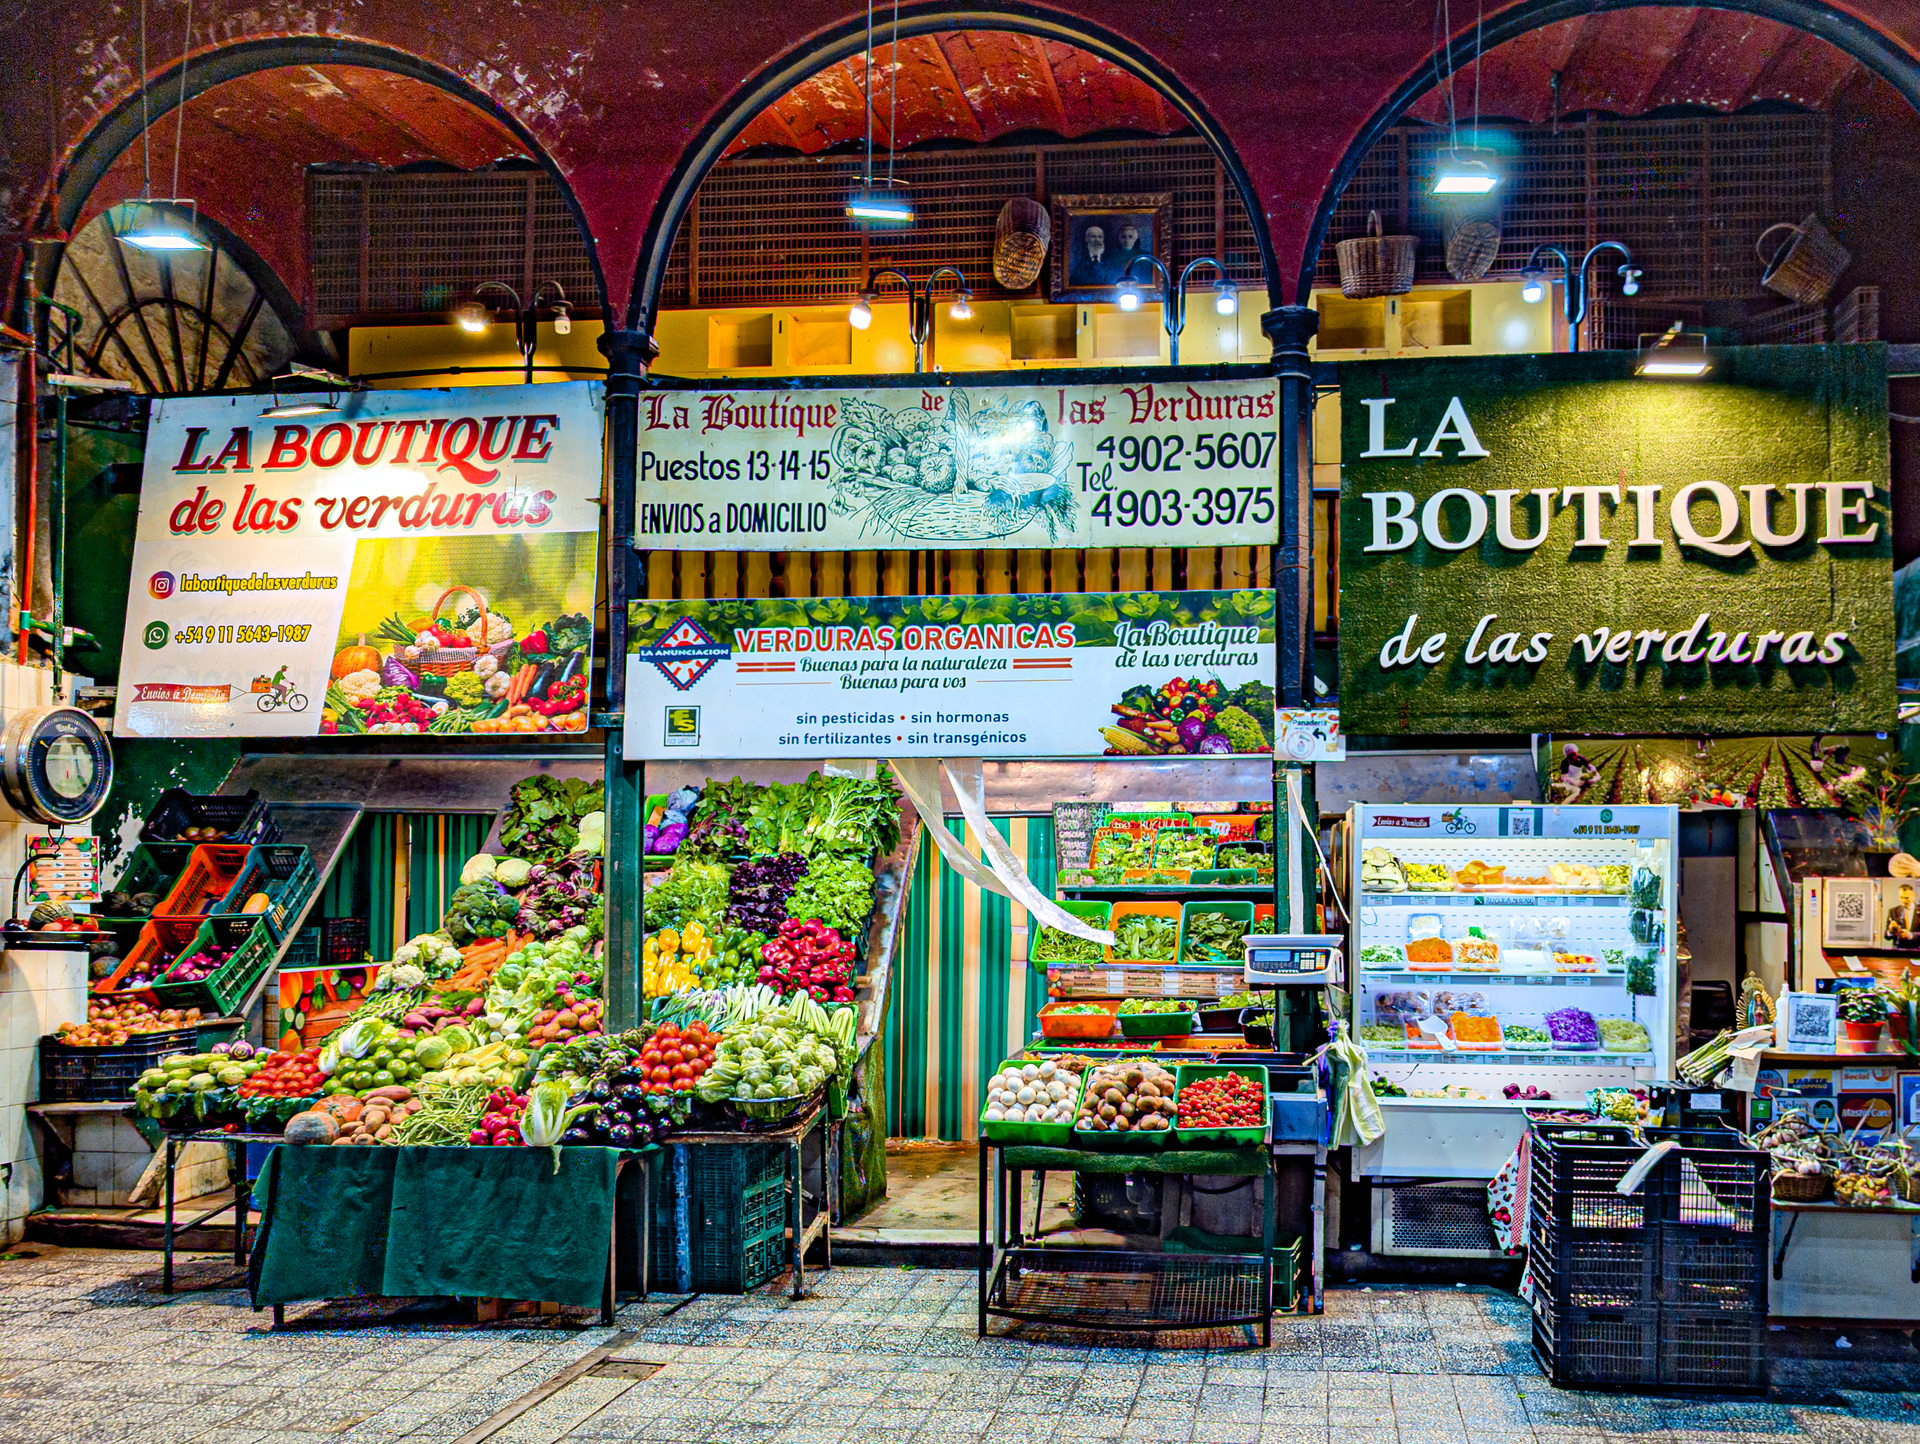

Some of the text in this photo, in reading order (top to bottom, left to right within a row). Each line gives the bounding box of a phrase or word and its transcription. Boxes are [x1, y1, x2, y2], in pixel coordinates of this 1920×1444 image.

[643, 384, 1275, 438] La Boutique de las Verduras
[1359, 396, 1490, 458] LA
[171, 415, 560, 484] LA BOUTIQUE
[641, 450, 741, 481] Puestos
[1077, 461, 1119, 492] Tel.
[169, 483, 555, 535] de las verduras
[641, 502, 827, 534] ENVIOS a DOMICILIO
[1362, 480, 1879, 557] BOUTIQUE
[180, 572, 338, 596] laboutiquedelasverduras
[175, 626, 203, 644] +54
[205, 626, 215, 643] 9
[236, 624, 311, 643] 5643-1987
[734, 623, 1076, 653] VERDURAS ORGANICAS
[1114, 620, 1260, 653] La Boutique
[1379, 612, 1850, 668] de las verduras
[640, 648, 729, 657] LA ANUNCIACION
[800, 655, 1008, 676] Buenas para la naturaleza
[1115, 649, 1259, 667] de las verduras
[141, 686, 171, 701] Envios
[840, 674, 967, 693] Buenas para vos
[796, 711, 1010, 729] sin pesticidas sin hormonas
[778, 730, 1027, 748] sin fertilizantes sin transgénicos
